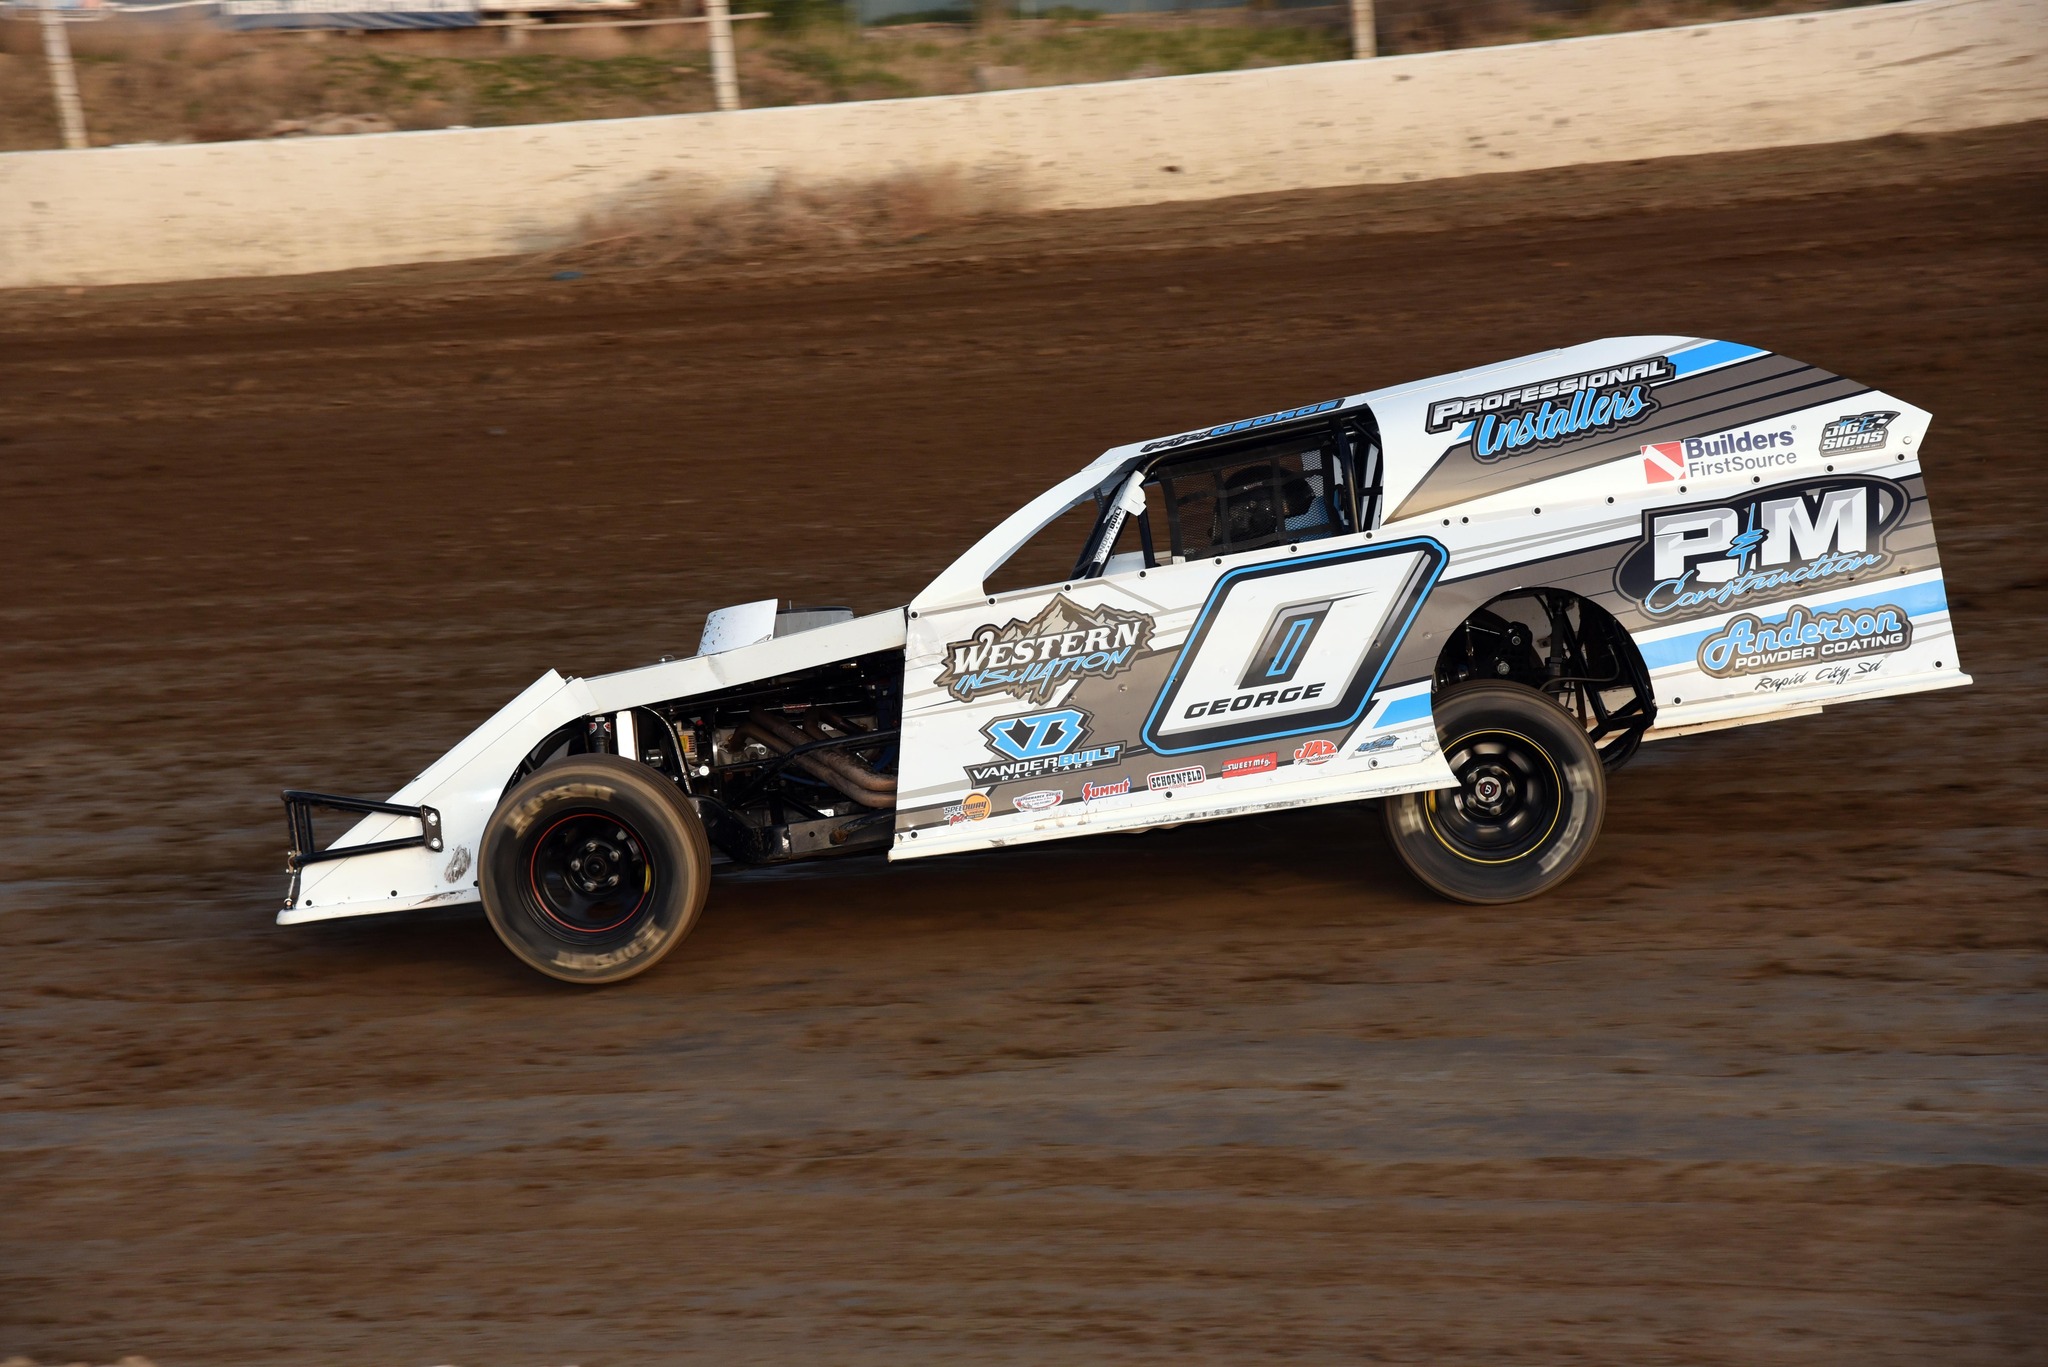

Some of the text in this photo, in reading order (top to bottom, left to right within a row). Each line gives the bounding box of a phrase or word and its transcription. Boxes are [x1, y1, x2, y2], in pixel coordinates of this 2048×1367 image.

[1432, 361, 1666, 426] PROFESSIONAL
[1477, 386, 1651, 456] Installers
[1685, 431, 1794, 460] Builders
[1822, 431, 1885, 450] SIGNS
[1689, 452, 1797, 477] FirstSource
[1645, 553, 1882, 613] Construction
[954, 621, 1142, 675] WESTERN
[1703, 610, 1901, 671] Anderson
[1735, 633, 1903, 669] POWDER COATING
[954, 646, 1132, 695] INSULATION
[1755, 671, 1809, 692] Rapid
[1183, 682, 1326, 720] GEORGE
[972, 746, 1120, 780] VANDERBUILT
[1295, 741, 1337, 759] JAZ
[1002, 761, 1093, 781] RACE CARS
[1151, 770, 1202, 788] SCHOENFELD
